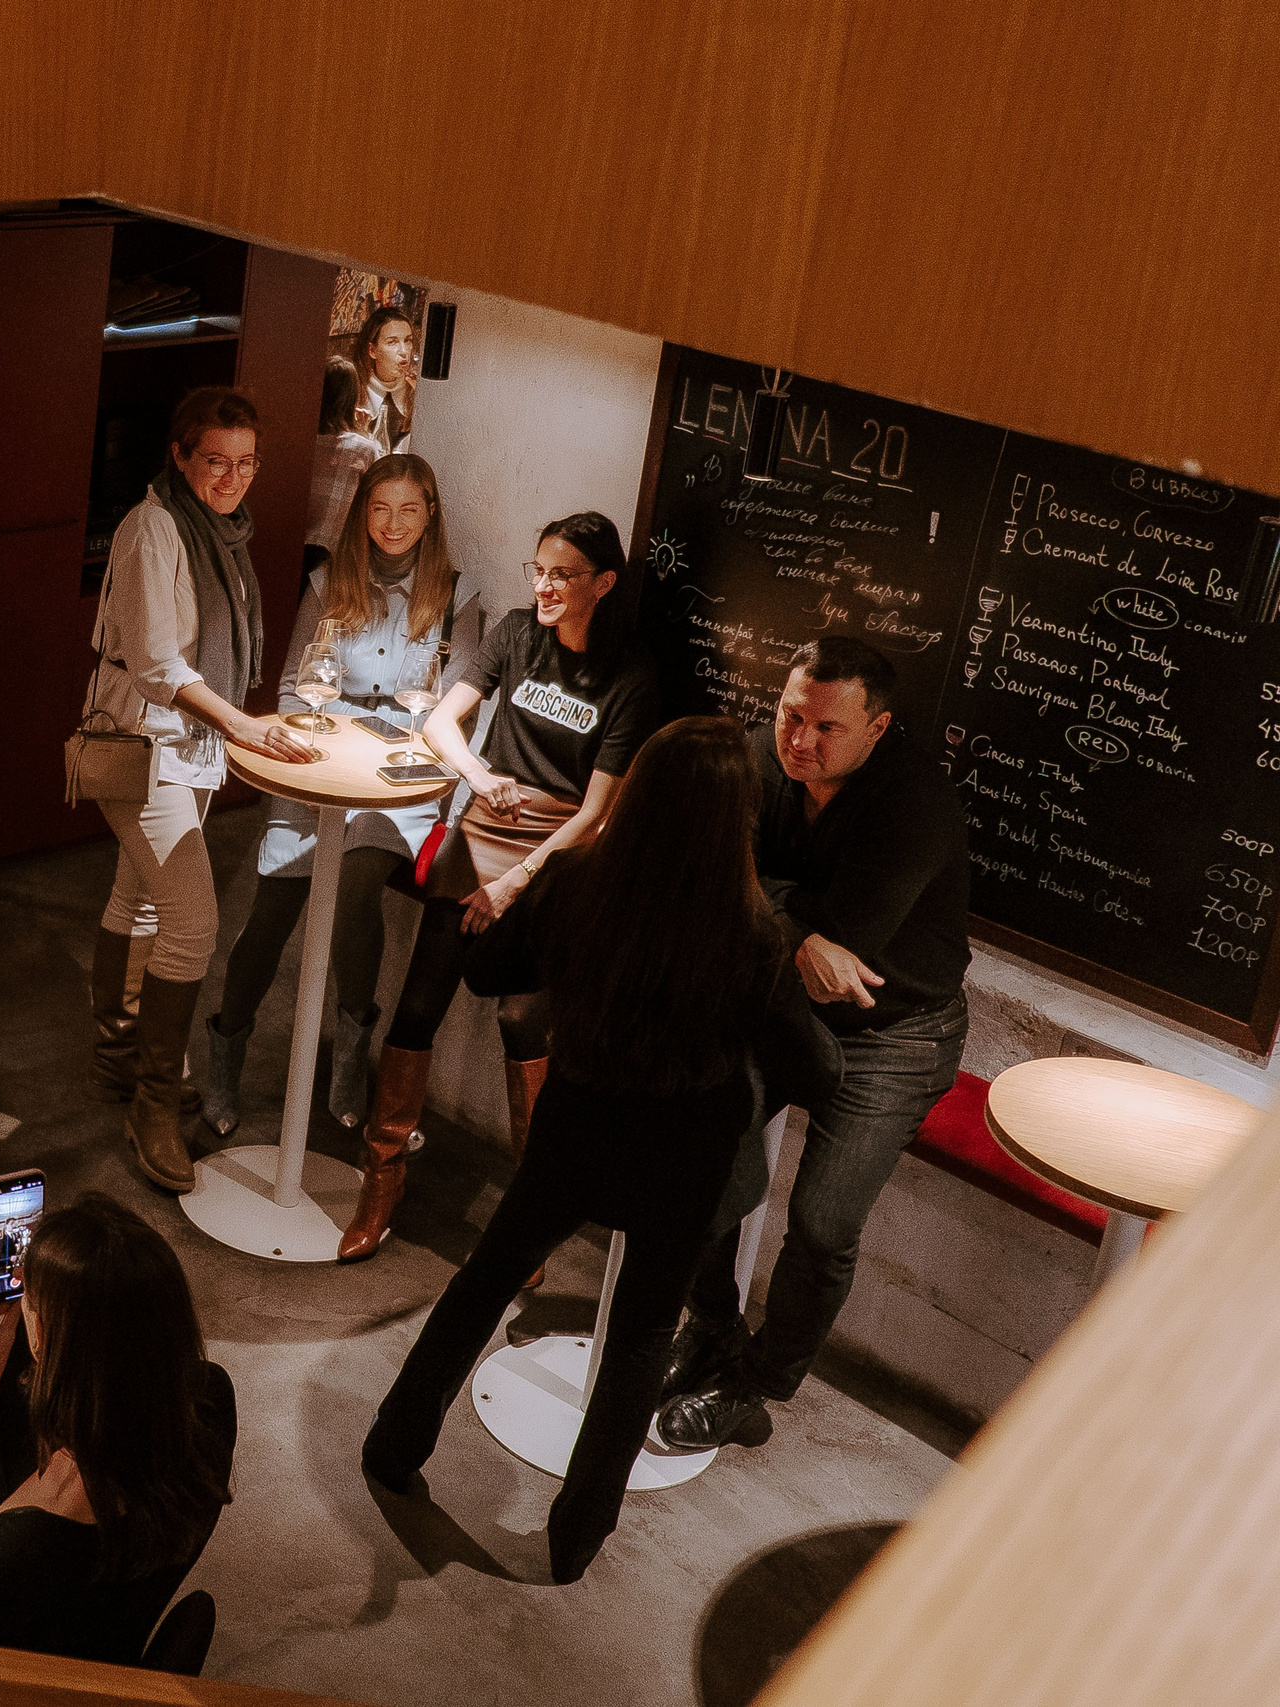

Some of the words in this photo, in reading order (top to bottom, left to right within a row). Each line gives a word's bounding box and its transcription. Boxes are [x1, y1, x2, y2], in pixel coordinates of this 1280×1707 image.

[678, 377, 831, 462] LENNA
[850, 418, 910, 481] 20
[1022, 527, 1111, 569] Cremant
[1117, 549, 1143, 577] de
[1156, 557, 1200, 596] Loire
[1115, 592, 1170, 623] white
[1127, 634, 1181, 678] Italy
[523, 683, 594, 730] MOSCHINO
[1090, 658, 1172, 711] Portugal
[990, 665, 1080, 717] Sauvignon
[1145, 714, 1189, 753] Italy
[1037, 759, 1085, 794] Italy
[1038, 790, 1088, 827] Spain
